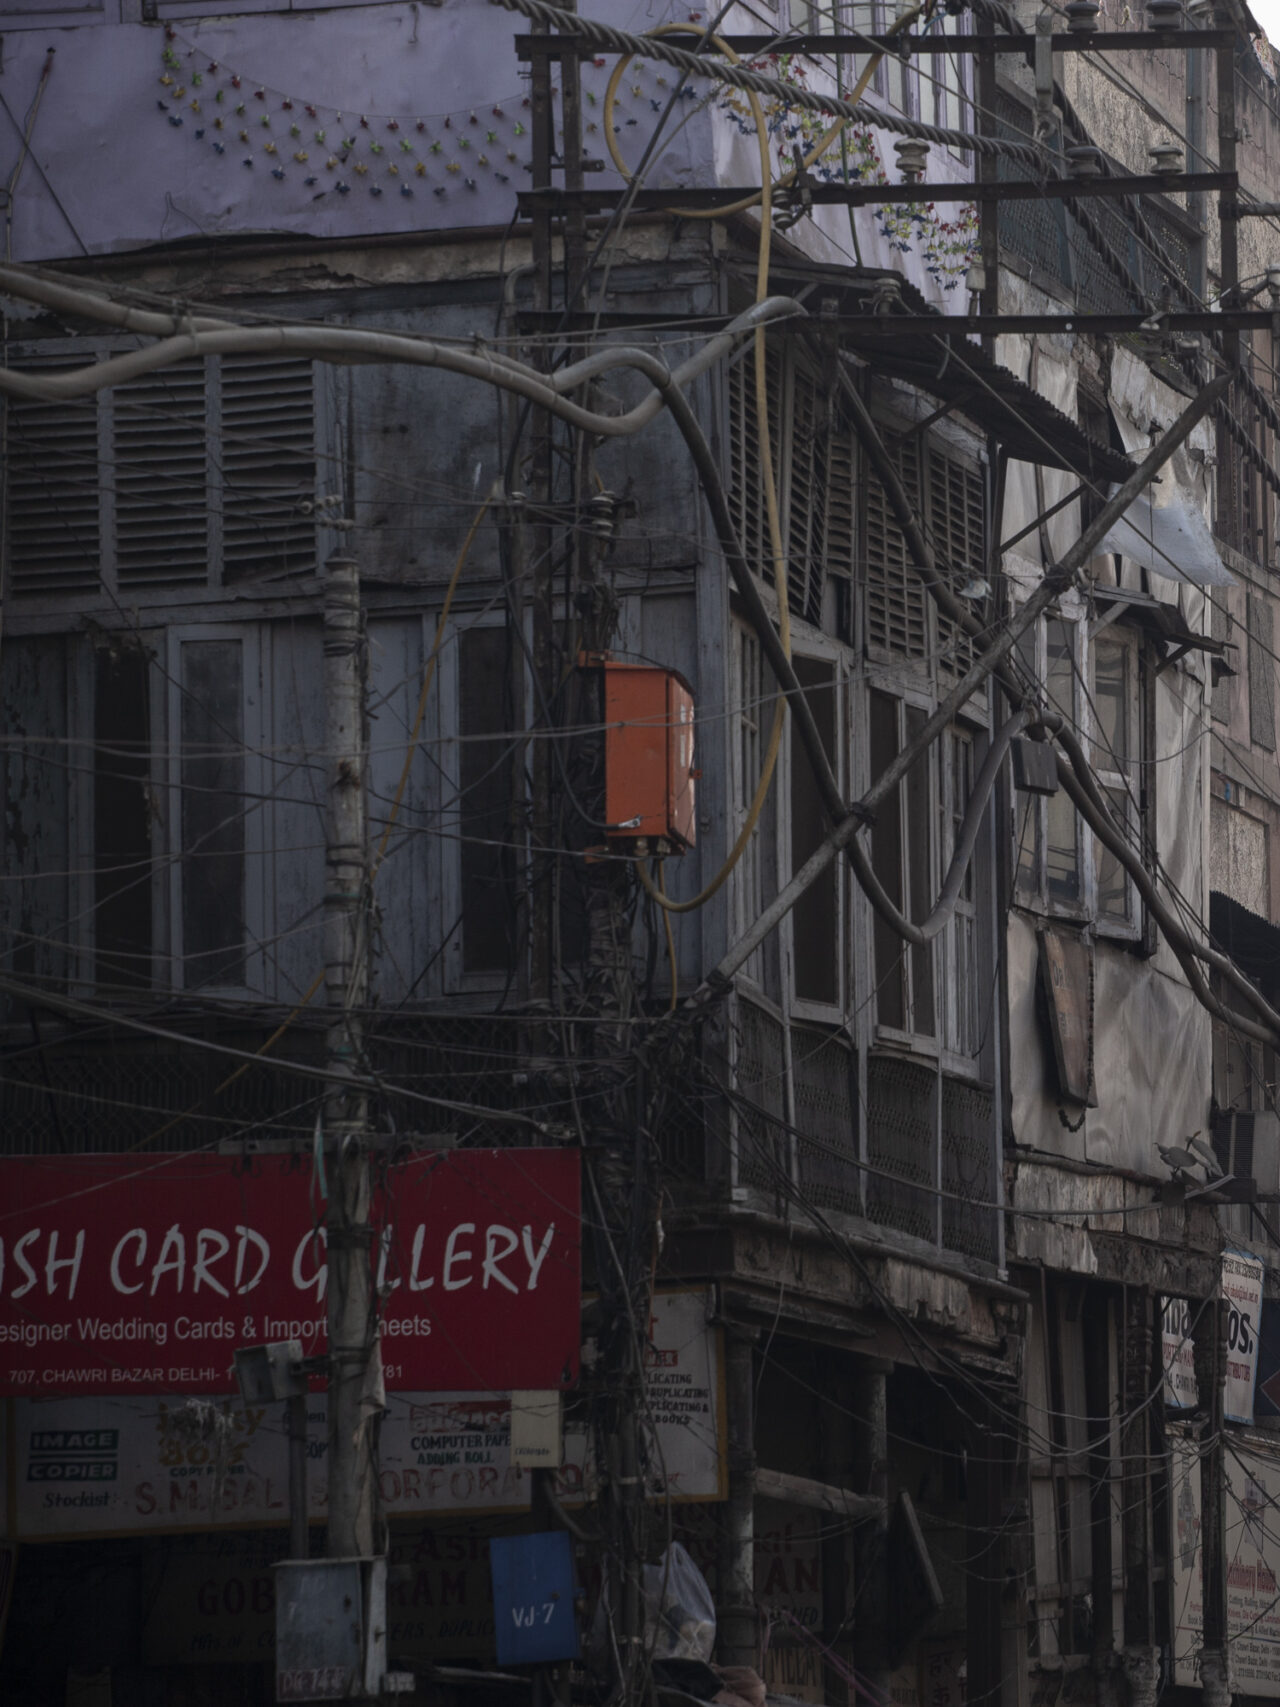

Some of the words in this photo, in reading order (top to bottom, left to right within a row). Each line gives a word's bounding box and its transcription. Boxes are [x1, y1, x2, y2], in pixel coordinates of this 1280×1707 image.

[0, 1227, 86, 1301] SH
[109, 1222, 271, 1299] CARD
[291, 1221, 556, 1304] GLLERY
[0, 1319, 71, 1348] esigner
[77, 1317, 168, 1346] Wedding
[173, 1315, 236, 1340] Cards
[241, 1314, 257, 1339] &
[263, 1313, 329, 1344] Import
[376, 1313, 432, 1337] heets
[9, 1369, 40, 1385] 707,
[42, 1368, 108, 1384] CHAWRI
[111, 1367, 165, 1383] BAZAR
[647, 1373, 692, 1385] LICATING
[33, 1432, 114, 1448] IMAGE
[410, 1433, 483, 1451] COMPUTER
[484, 1434, 510, 1449] PAPE
[416, 1451, 461, 1465] ADDING
[30, 1463, 115, 1478] COPIER
[169, 1465, 202, 1478] COPY
[511, 1602, 556, 1629] VJ-7
